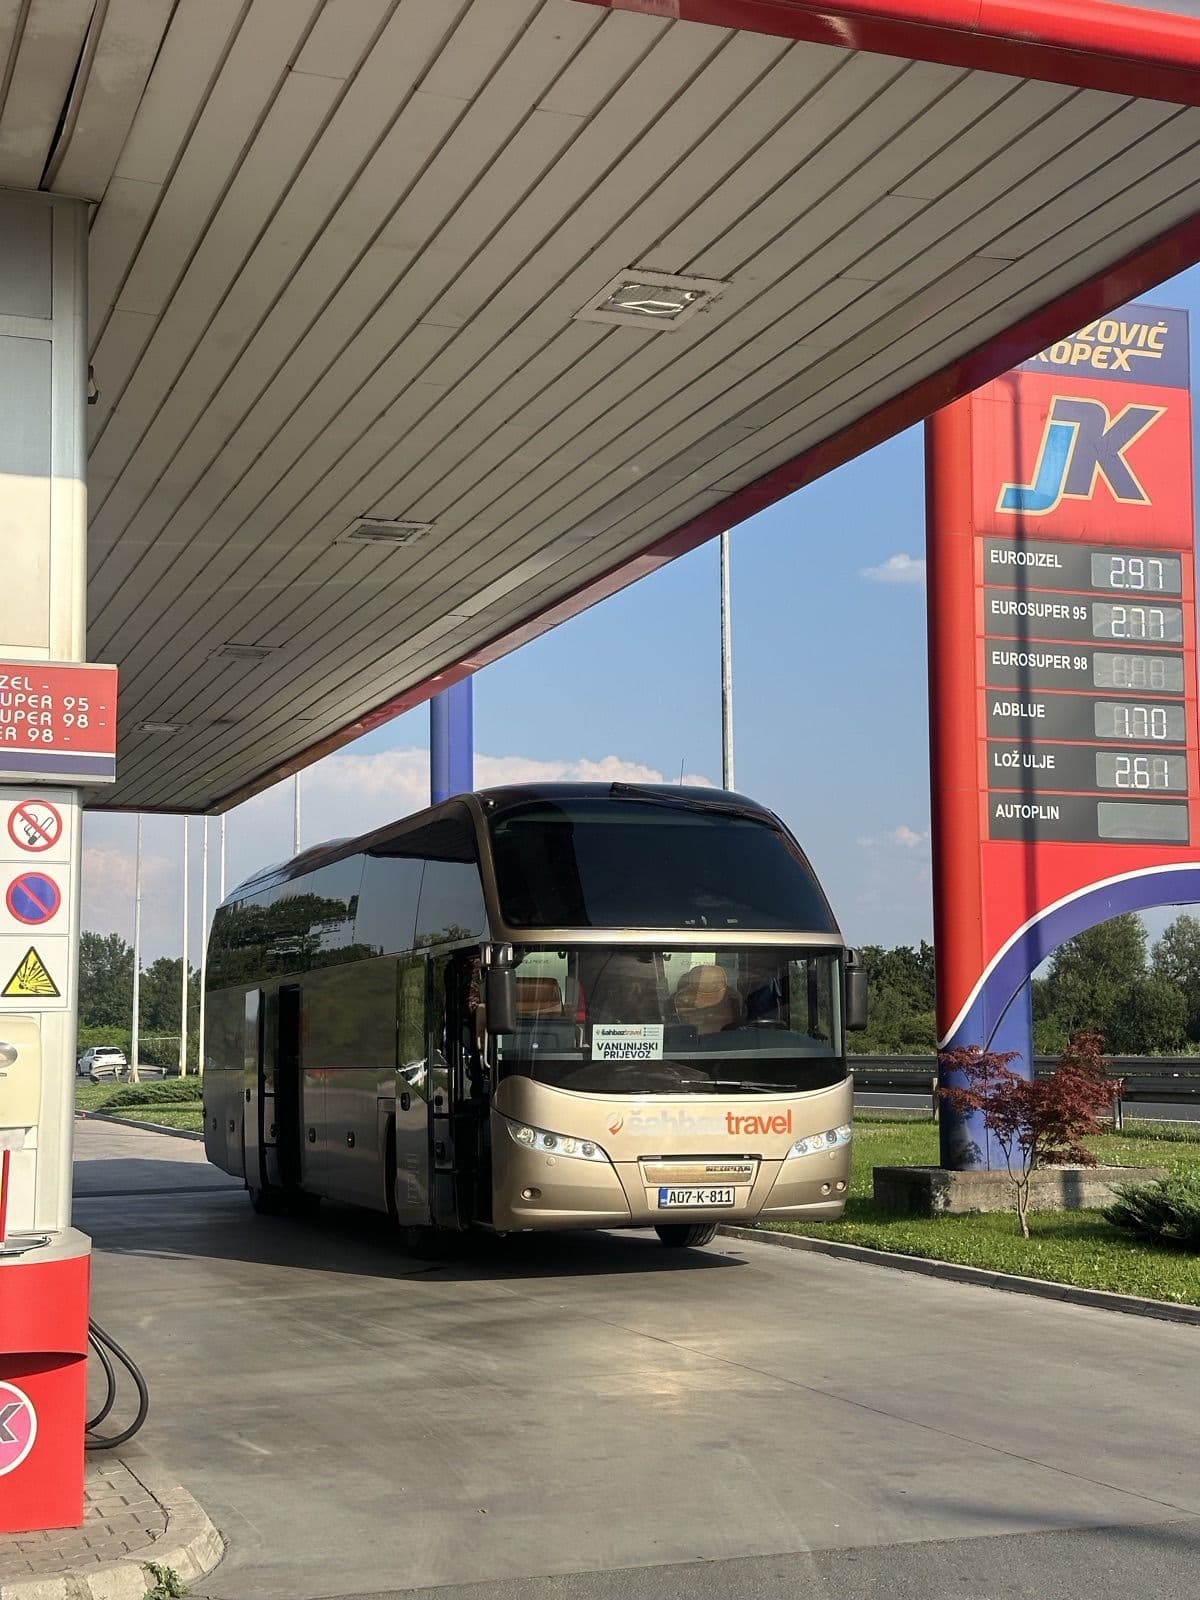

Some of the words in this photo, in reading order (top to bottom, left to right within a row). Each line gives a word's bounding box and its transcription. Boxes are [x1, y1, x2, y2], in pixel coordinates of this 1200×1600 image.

[1068, 320, 1168, 350] ZOVIĆ
[990, 549, 1063, 569] EURODIZEL
[1110, 556, 1163, 590] 2.97
[991, 599, 1070, 620] EUROSUPER
[1072, 607, 1087, 621] 95
[1111, 606, 1164, 639] 2.77
[992, 650, 1071, 671] EUROSUPER
[1073, 656, 1088, 671] 98
[0, 675, 33, 691] ZEL
[0, 692, 52, 710] UPER
[63, 696, 89, 712] 95
[0, 709, 52, 726] UPER
[62, 713, 89, 729] 98
[992, 701, 1045, 718] ADBLUE
[1124, 707, 1167, 740] 1.70
[0, 726, 17, 741] R
[27, 727, 54, 743] 98
[994, 750, 1020, 768] LOŽ
[1023, 754, 1055, 769] ULJE
[1115, 756, 1169, 788] 2.61
[995, 803, 1060, 820] AUTOPLIN
[597, 1042, 658, 1051] VANLINIJSKI
[604, 1050, 651, 1059] PRIJEVOZ
[669, 1190, 732, 1204] A07-K-811
